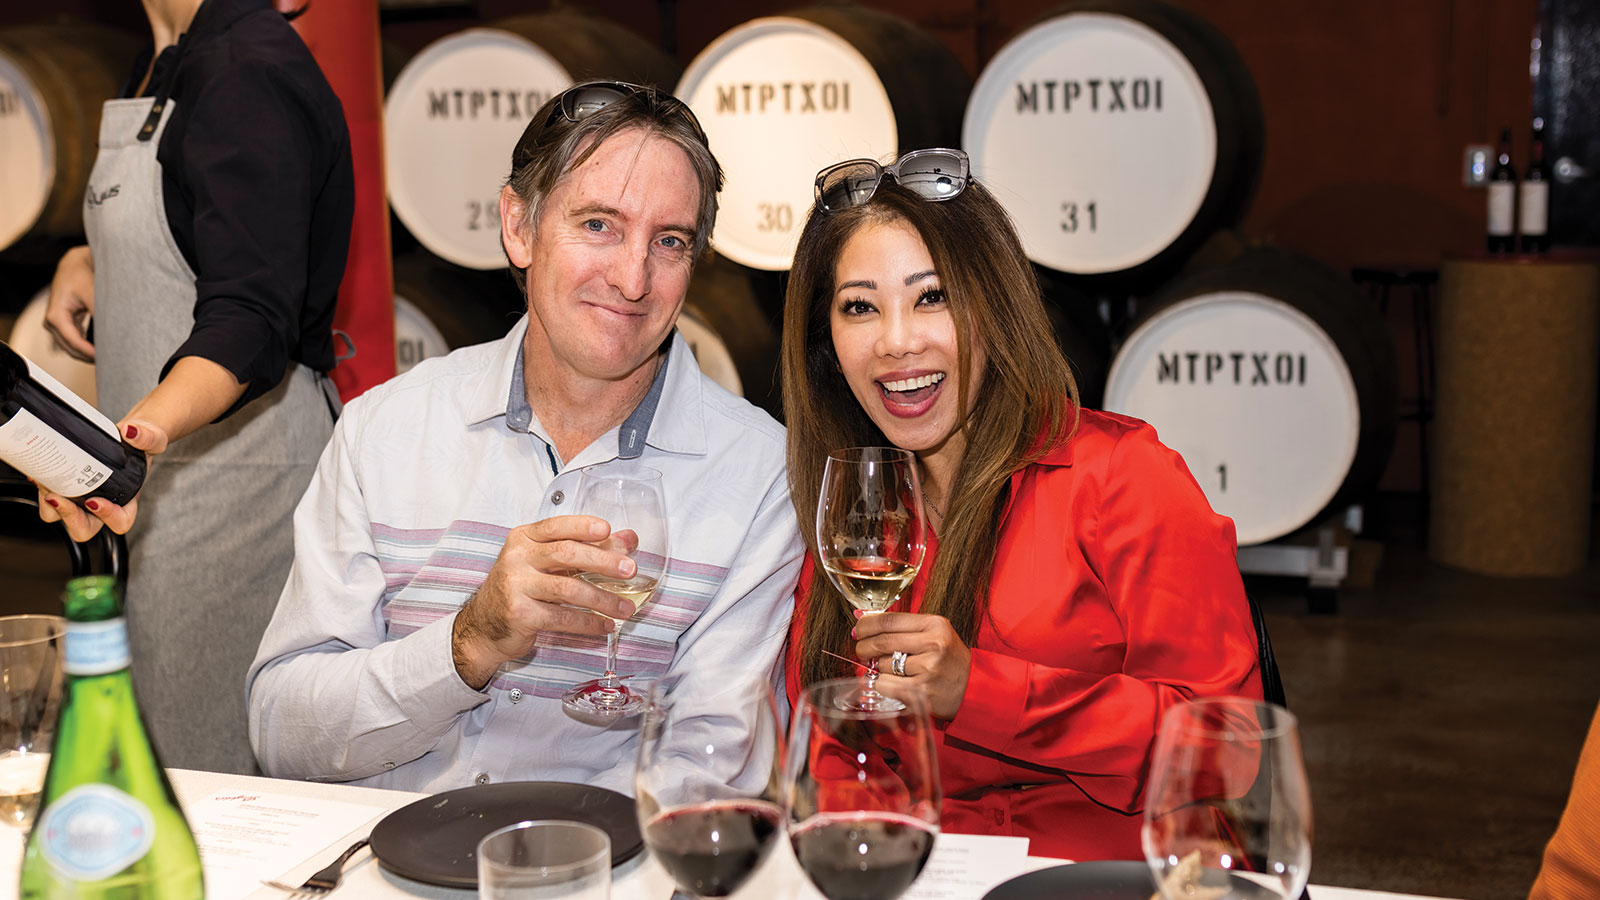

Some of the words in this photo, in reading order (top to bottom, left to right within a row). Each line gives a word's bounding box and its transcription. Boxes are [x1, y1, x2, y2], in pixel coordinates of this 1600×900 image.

[756, 201, 793, 232] 30
[1061, 202, 1098, 232] 31
[1217, 464, 1228, 492] 1
